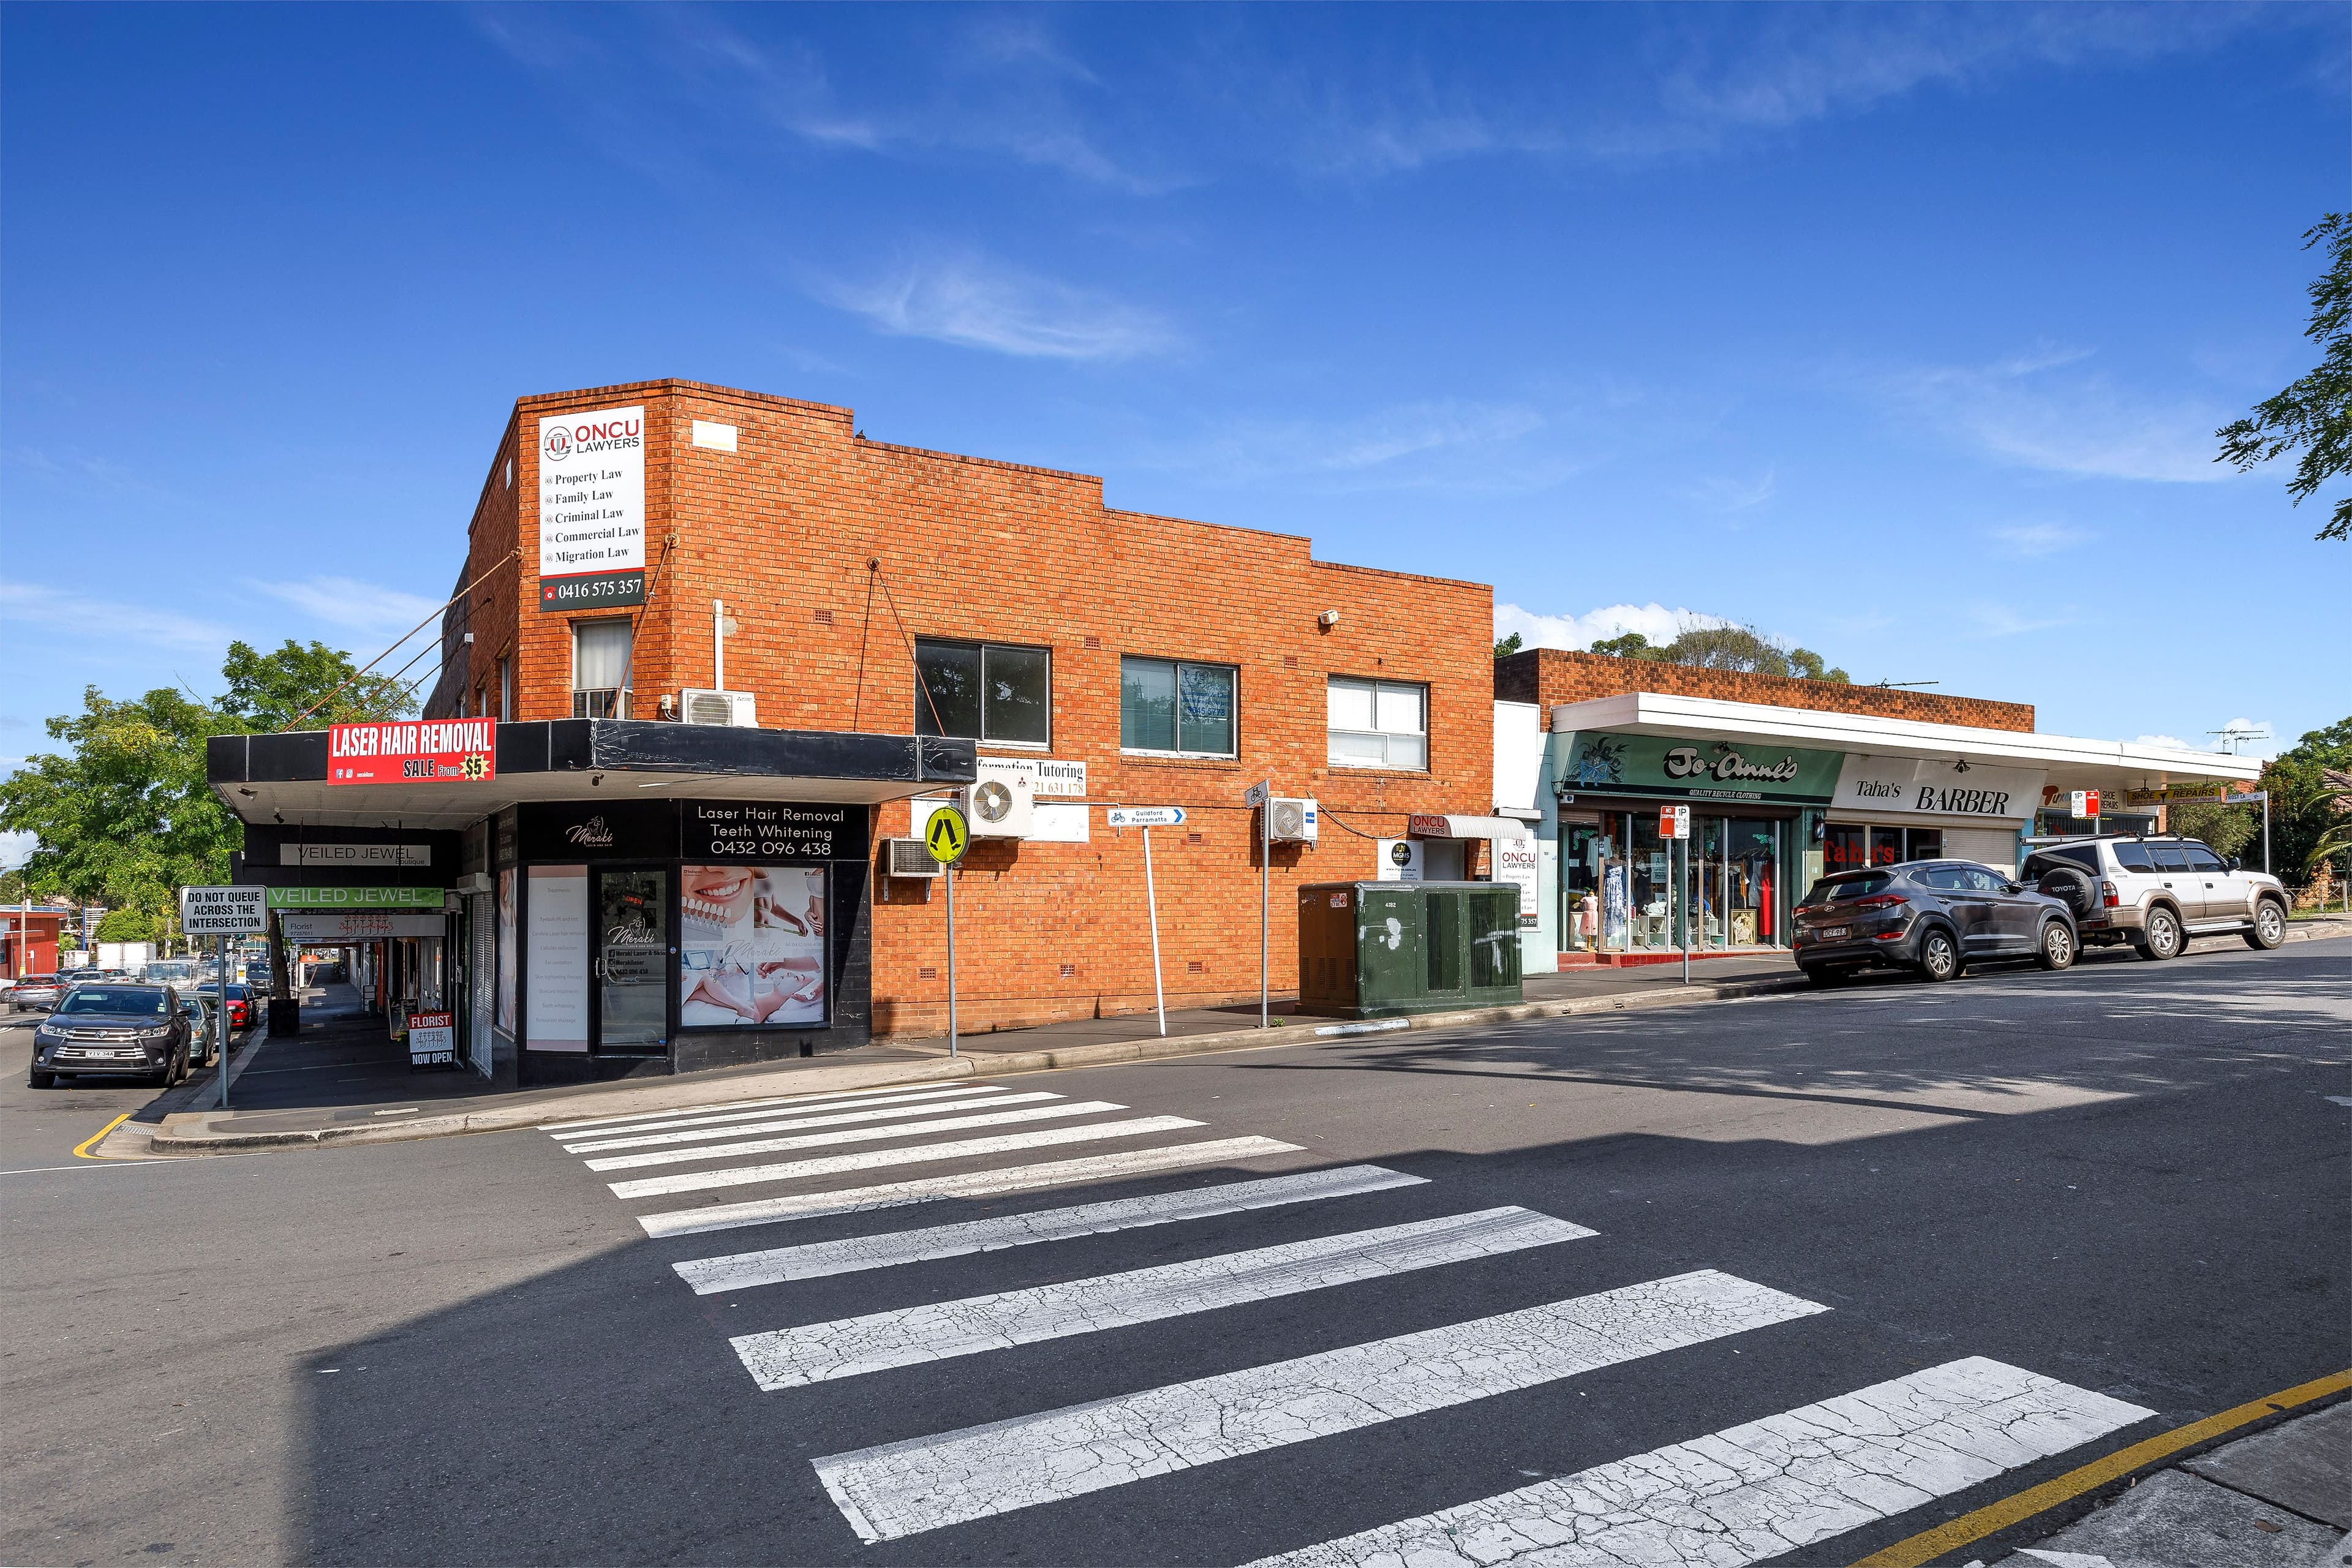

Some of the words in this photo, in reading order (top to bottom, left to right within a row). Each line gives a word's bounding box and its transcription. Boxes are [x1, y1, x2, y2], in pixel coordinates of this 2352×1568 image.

[575, 419, 639, 441] ONCU
[577, 437, 639, 453] LAWYERS
[556, 472, 598, 485] Property
[601, 470, 622, 480] Law
[556, 492, 589, 504] Family
[592, 491, 613, 500] Law
[556, 510, 599, 523] Criminal
[603, 509, 624, 519] Law
[556, 528, 614, 543] Commercial
[619, 527, 639, 537] Law
[556, 549, 604, 564] Migration
[608, 548, 629, 558] Law
[559, 582, 589, 598] 0416
[592, 581, 614, 597] 575
[618, 579, 641, 594] 357
[333, 726, 379, 757] LASER
[381, 725, 417, 755] HAIR
[420, 722, 491, 754] REMOVAL
[404, 760, 434, 777] SALE
[438, 765, 458, 777] From
[466, 757, 481, 777] $5
[1036, 762, 1083, 782] Tutoring
[1049, 782, 1063, 793] 631
[1068, 783, 1083, 794] 178
[2173, 788, 2215, 798] REPAIRS
[1856, 780, 1901, 798] Taha's
[1915, 786, 2009, 815] BARBER
[2042, 785, 2071, 806] Tuxa
[2102, 791, 2116, 800] SHOE
[2101, 801, 2119, 810] REPAIRS
[698, 806, 739, 819] Laser
[746, 807, 777, 820] Hair
[784, 809, 843, 821] Removal
[1414, 816, 1445, 827] ONCU
[566, 825, 612, 845] Meraki
[710, 824, 752, 837] Teeth
[758, 825, 832, 841] Whitening
[298, 847, 356, 859] VEILED
[361, 848, 414, 859] JEWEL
[711, 842, 756, 854] 0432
[762, 842, 795, 854] 096
[801, 843, 831, 855] 438
[1502, 853, 1536, 863] ONCU
[189, 892, 202, 902] DO
[205, 892, 225, 902] NOT
[228, 892, 260, 903] QUEUE
[271, 889, 348, 902] VEILED
[354, 888, 423, 902] JEWEL
[626, 895, 643, 905] OPEN
[194, 905, 233, 915] ACROSS
[236, 905, 255, 914] THE
[189, 918, 260, 928] INTERSECTION
[608, 926, 655, 945] Meraki
[412, 1016, 450, 1028] FLORIST
[412, 1054, 430, 1065] NOW
[432, 1052, 452, 1063] OPEN
